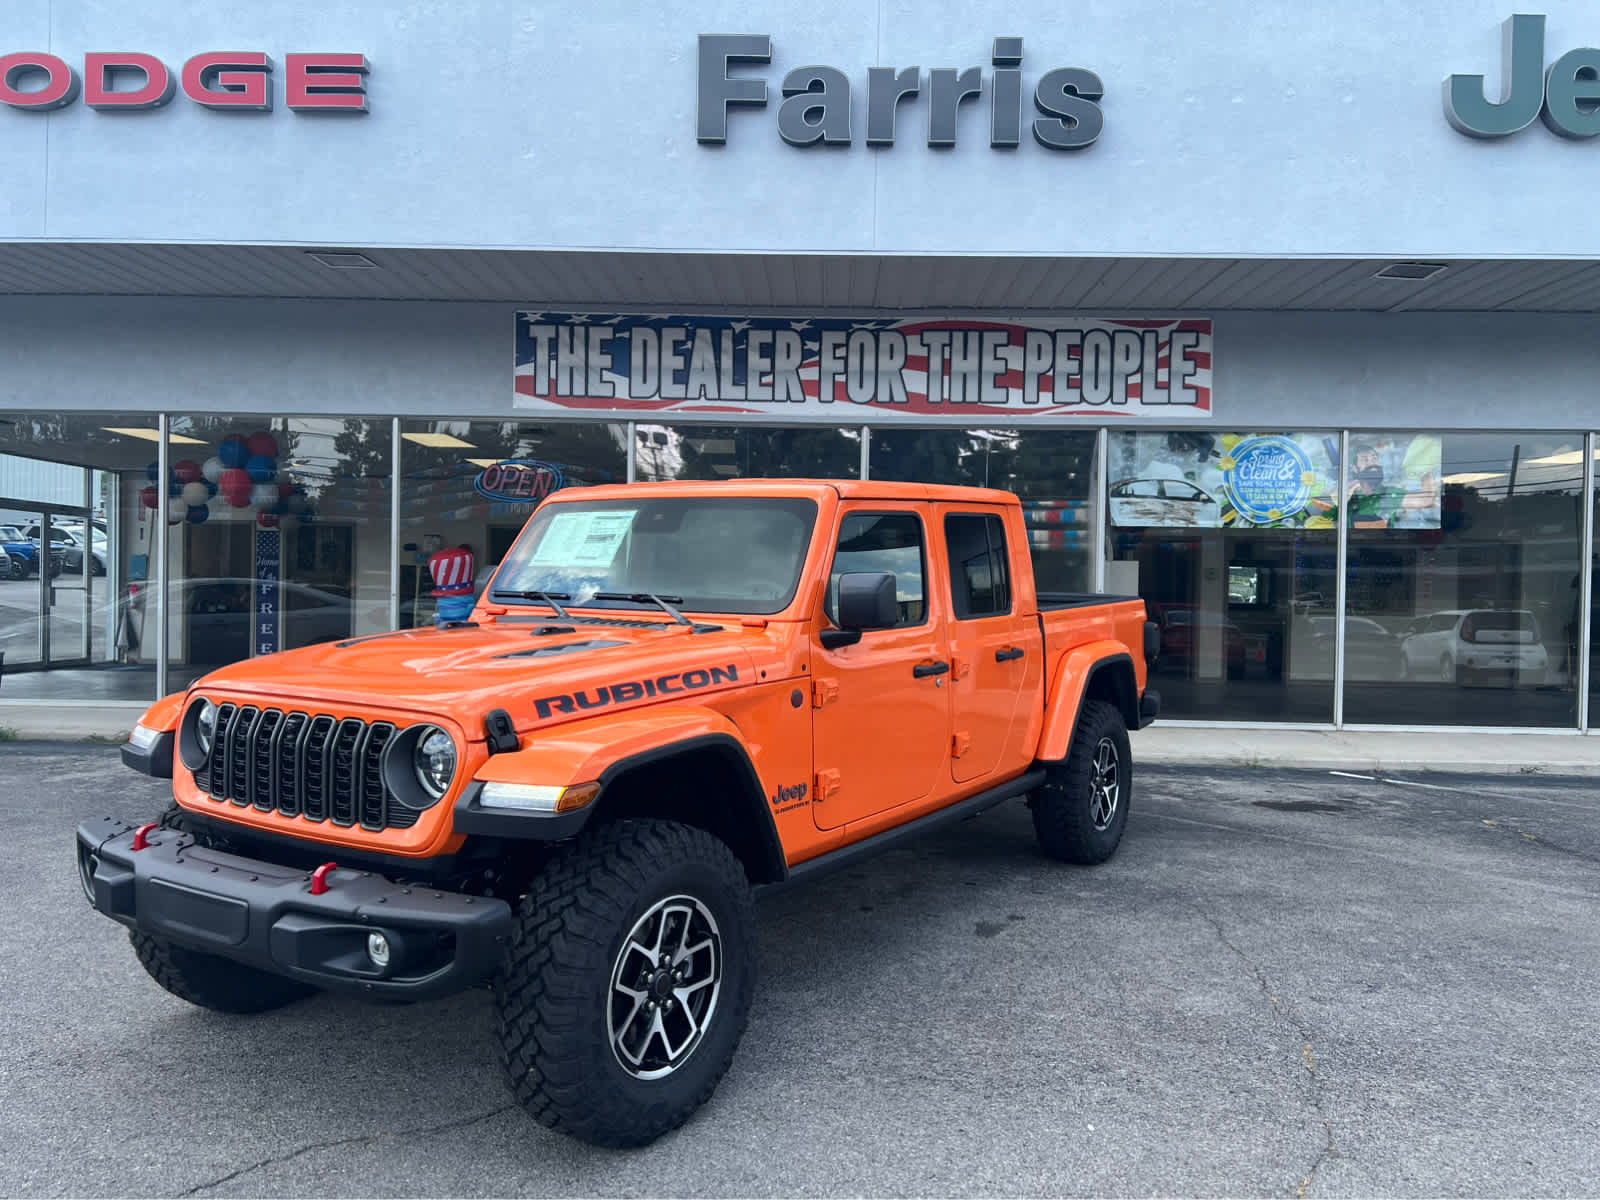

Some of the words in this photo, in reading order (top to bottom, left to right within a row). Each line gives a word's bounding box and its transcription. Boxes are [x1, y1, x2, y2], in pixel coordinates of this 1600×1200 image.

[0, 52, 369, 112] ODGE
[695, 33, 1105, 150] Farris
[1441, 14, 1600, 140] Je
[528, 323, 616, 398] THE
[627, 325, 806, 404] DEALER
[817, 328, 908, 404] FOR
[920, 329, 1010, 404] THE
[1022, 329, 1200, 406] PEOPLE
[482, 463, 553, 498] OPEN
[1238, 459, 1277, 480] Clean
[1248, 449, 1286, 469] Spring
[533, 664, 738, 719] RUBICON
[772, 782, 808, 805] Jeep
